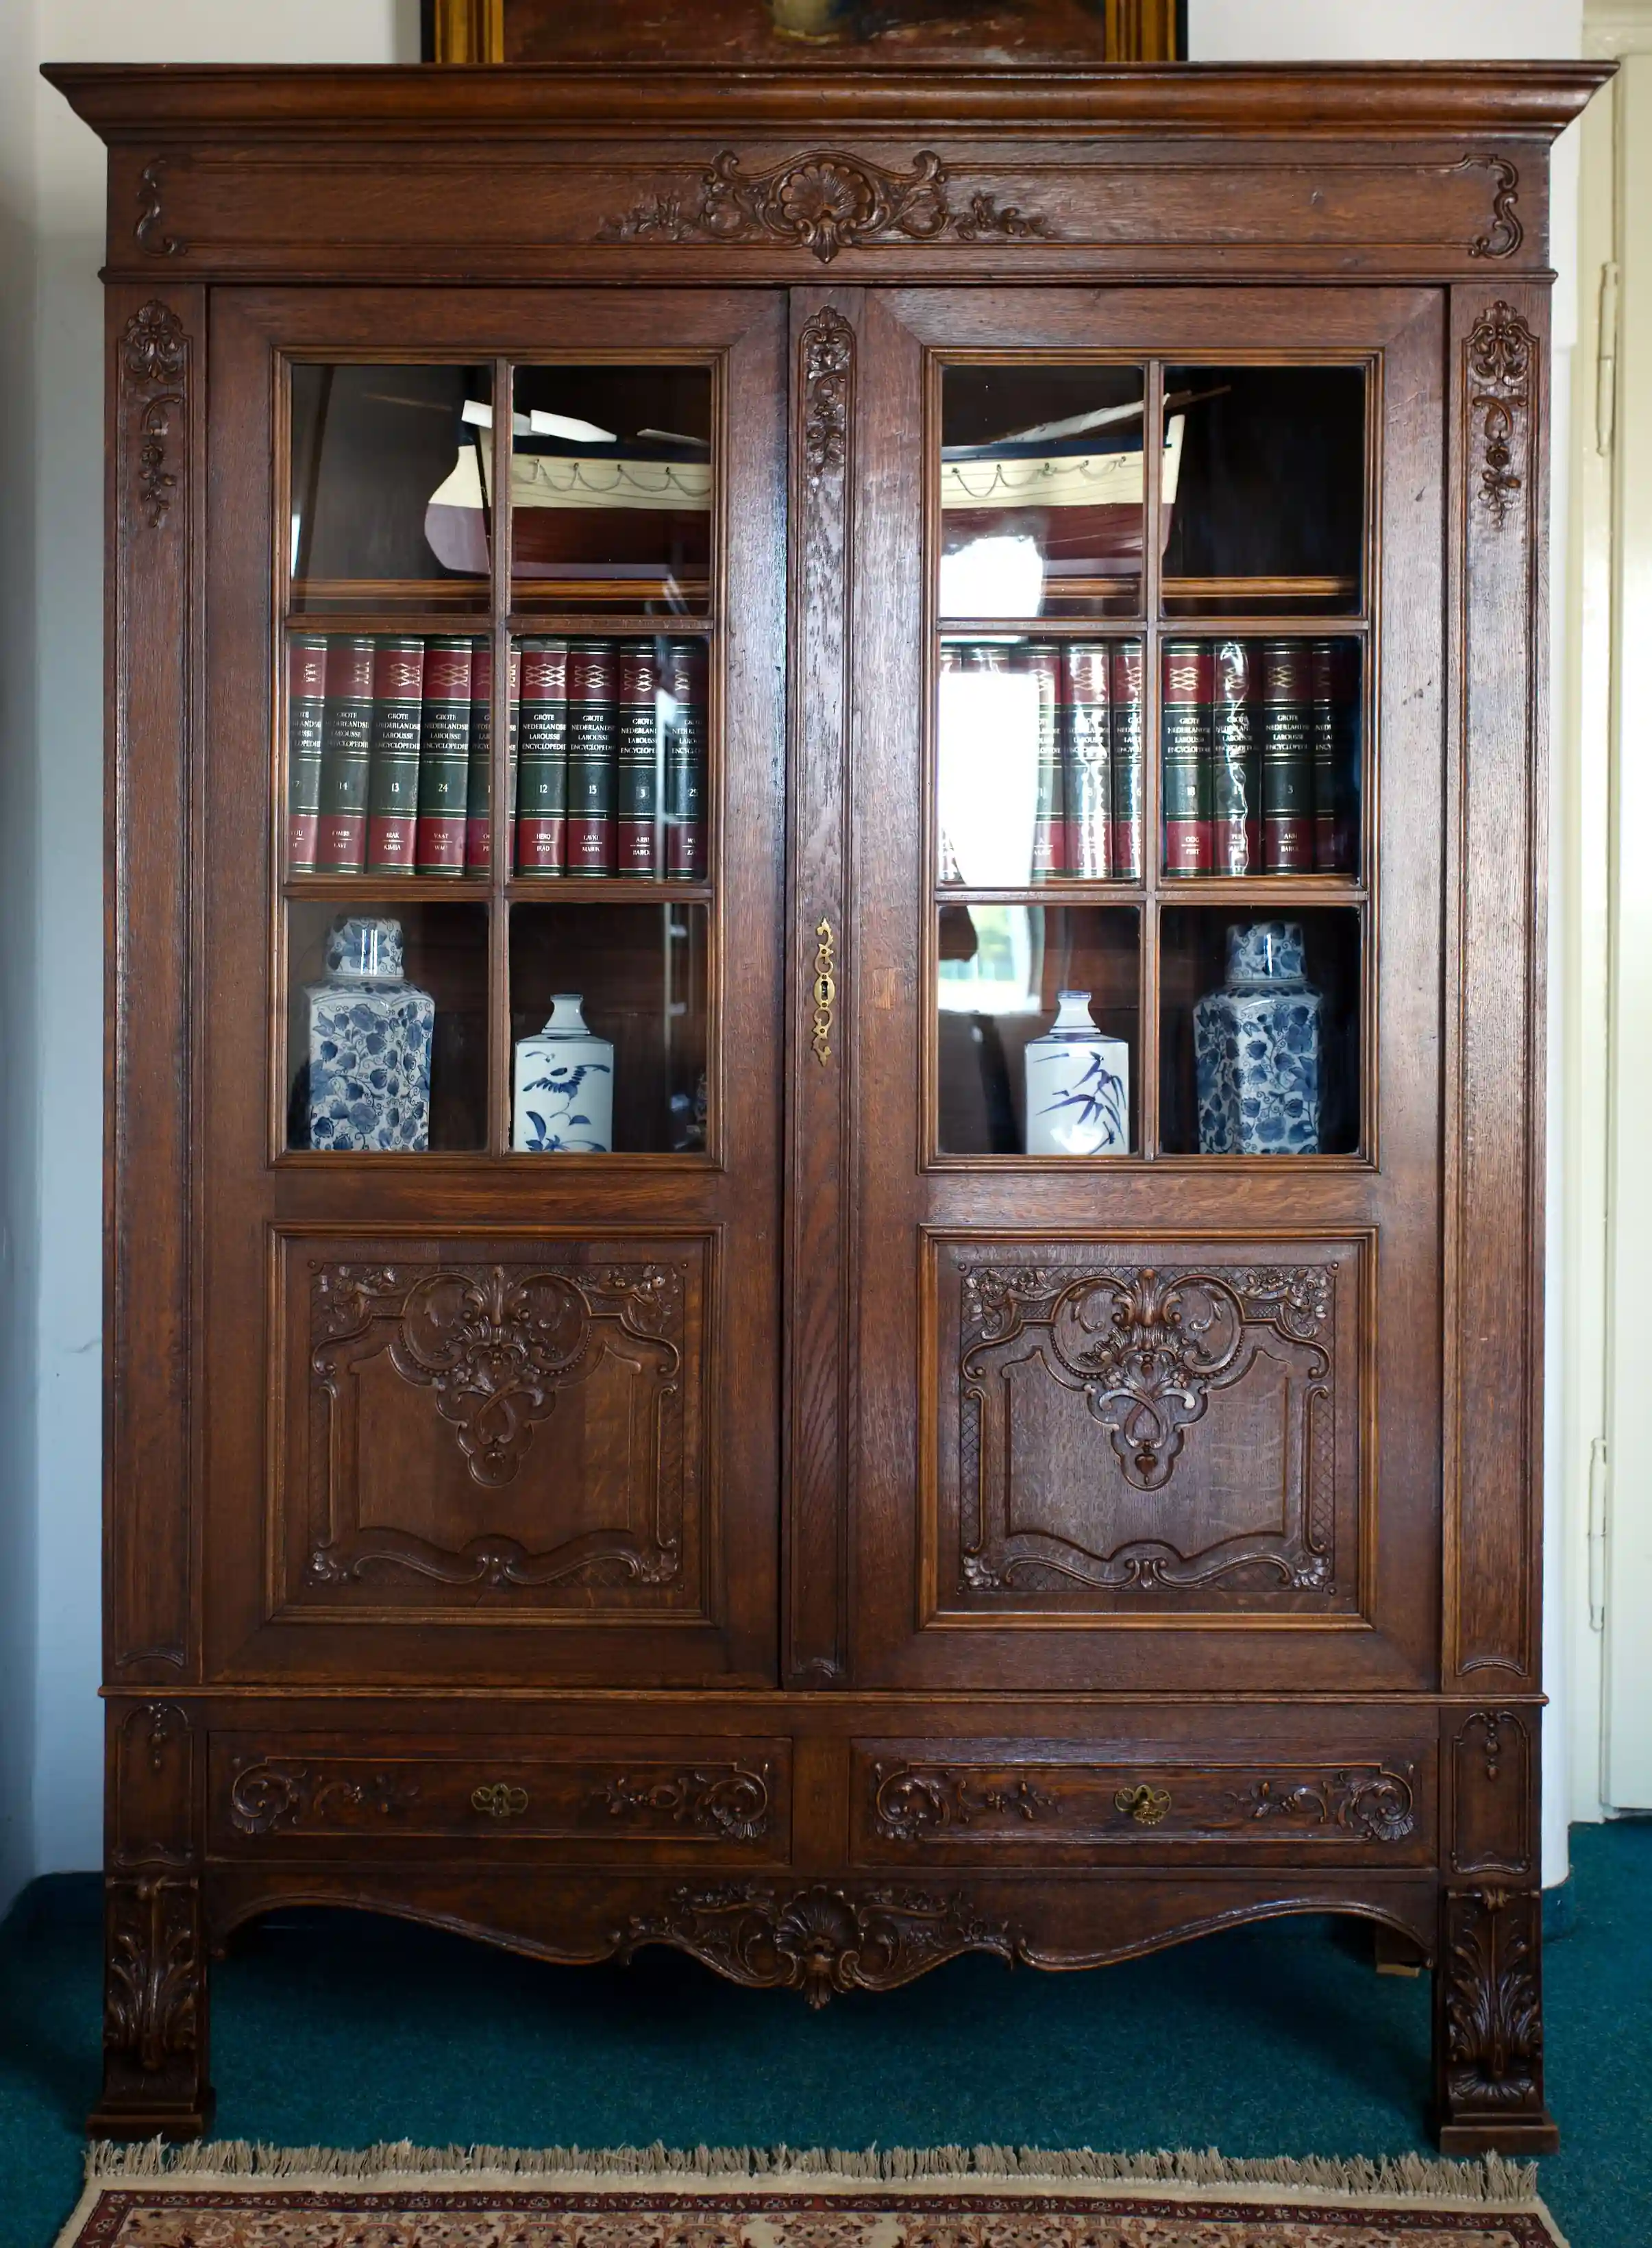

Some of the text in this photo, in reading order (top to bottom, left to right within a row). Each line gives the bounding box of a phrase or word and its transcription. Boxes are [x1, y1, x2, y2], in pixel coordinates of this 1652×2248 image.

[424, 722, 469, 731] NEDERLANDSE
[338, 781, 348, 790] 14
[391, 783, 399, 792] 13
[438, 783, 447, 792] 24
[539, 784, 548, 793] 12
[589, 785, 597, 794] 15
[1287, 785, 1294, 794] 3
